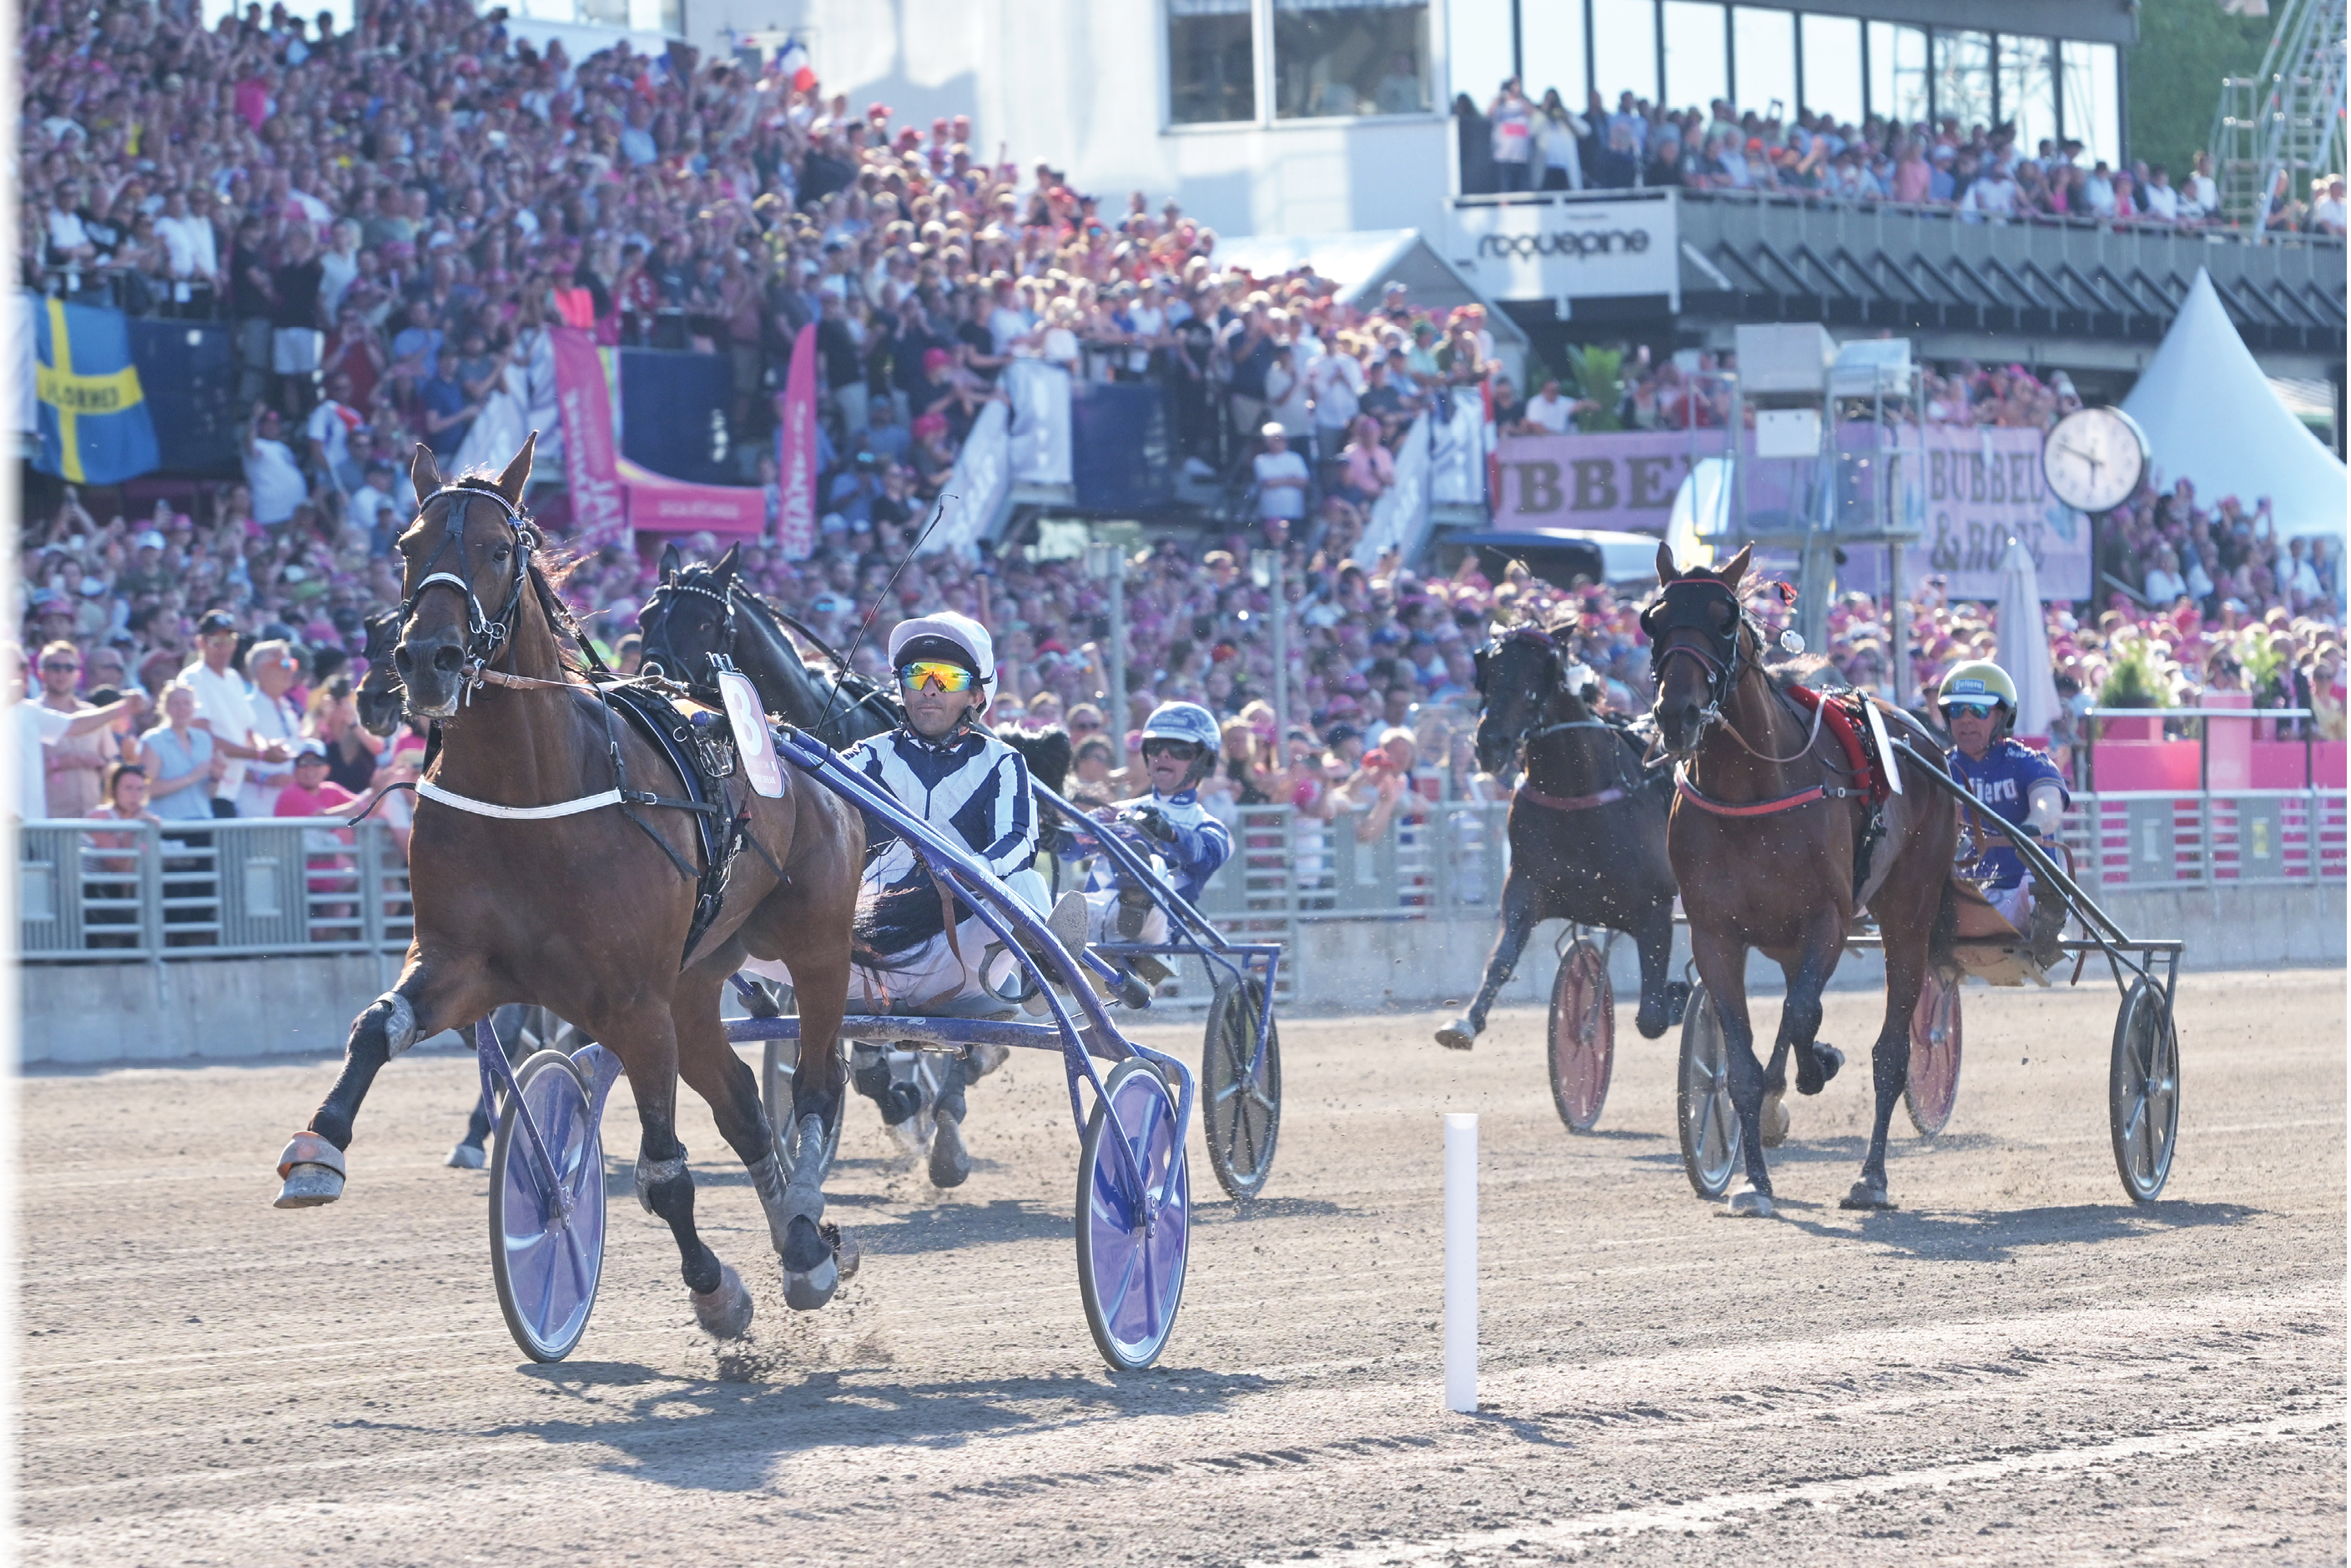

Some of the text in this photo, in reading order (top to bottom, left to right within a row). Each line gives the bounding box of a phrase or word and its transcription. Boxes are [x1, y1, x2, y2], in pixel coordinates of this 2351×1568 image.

[1478, 228, 1649, 263] roquepine
[1930, 448, 2045, 504] BUBBEL
[1931, 512, 1960, 572] &
[726, 679, 763, 756] 3
